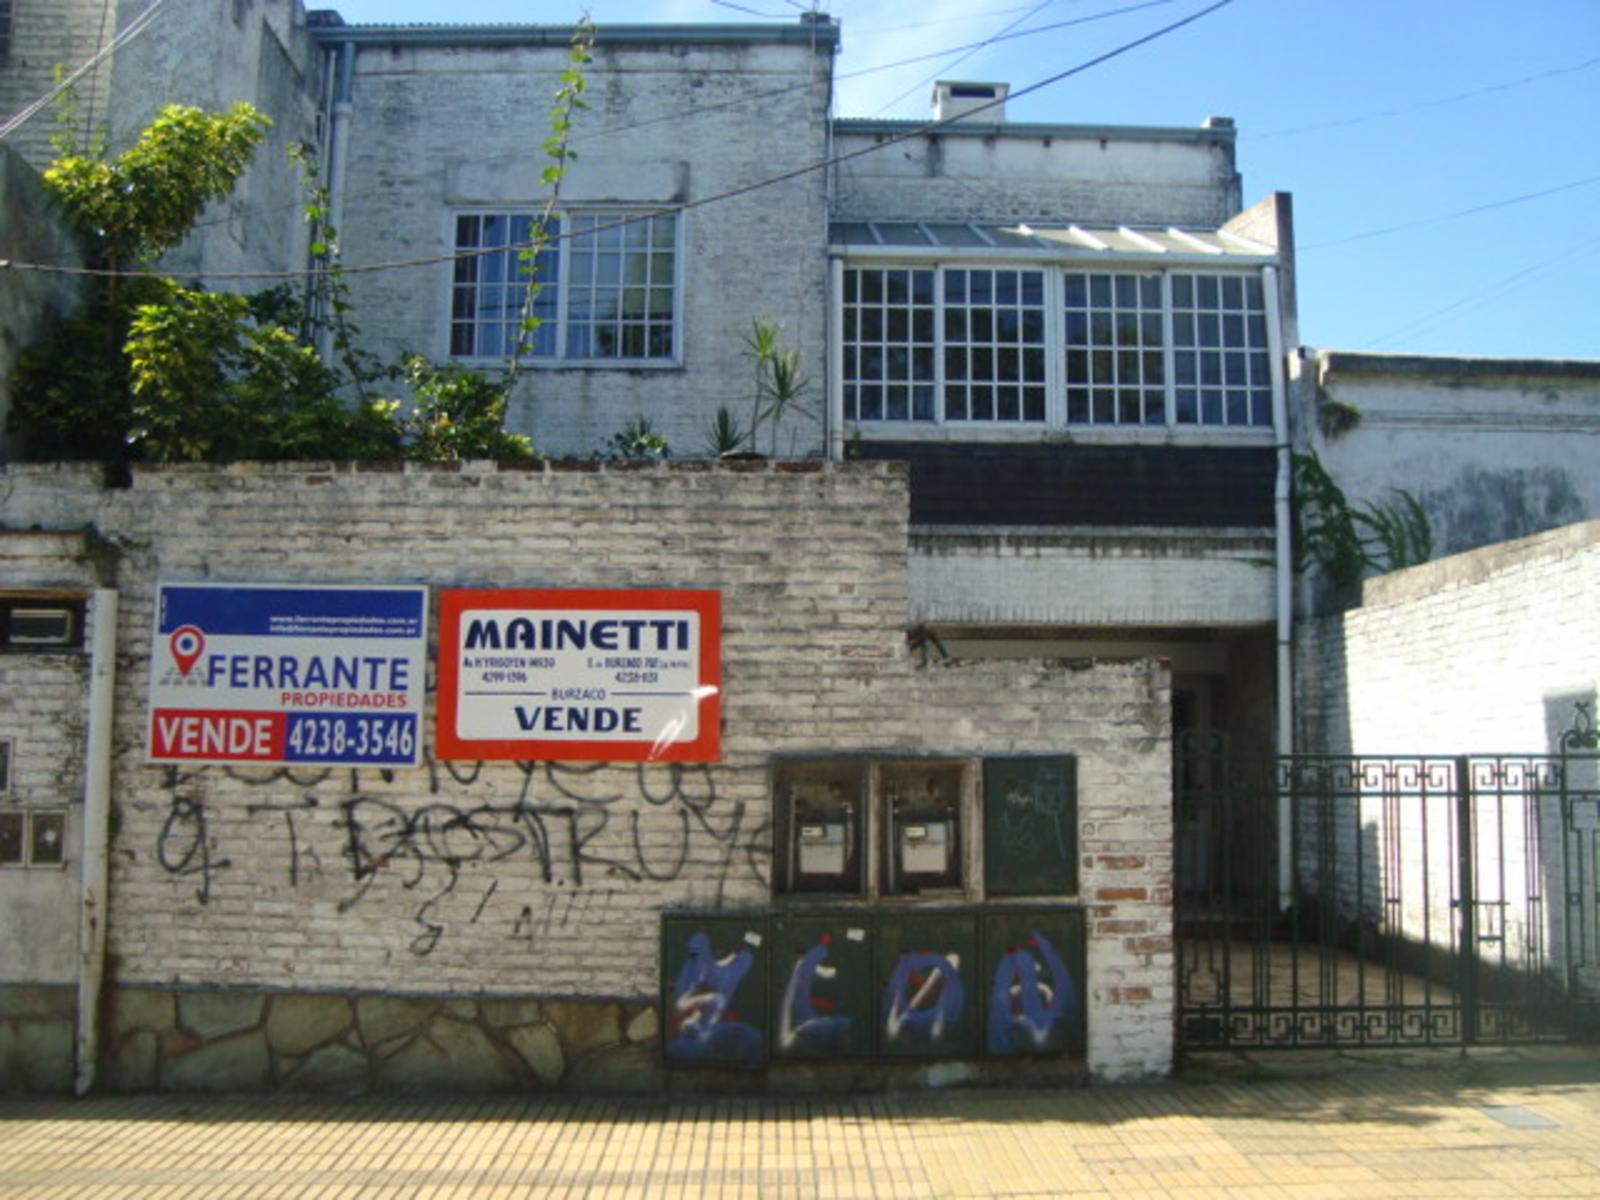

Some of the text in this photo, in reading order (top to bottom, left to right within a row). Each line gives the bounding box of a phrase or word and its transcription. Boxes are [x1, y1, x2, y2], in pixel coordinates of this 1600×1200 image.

[464, 618, 689, 650] MAINETTI
[207, 654, 410, 690] FERRANTE
[281, 691, 408, 708] PROPIEDADES
[514, 707, 643, 732] VENDE
[158, 716, 414, 757] VENDE 4238-3546
